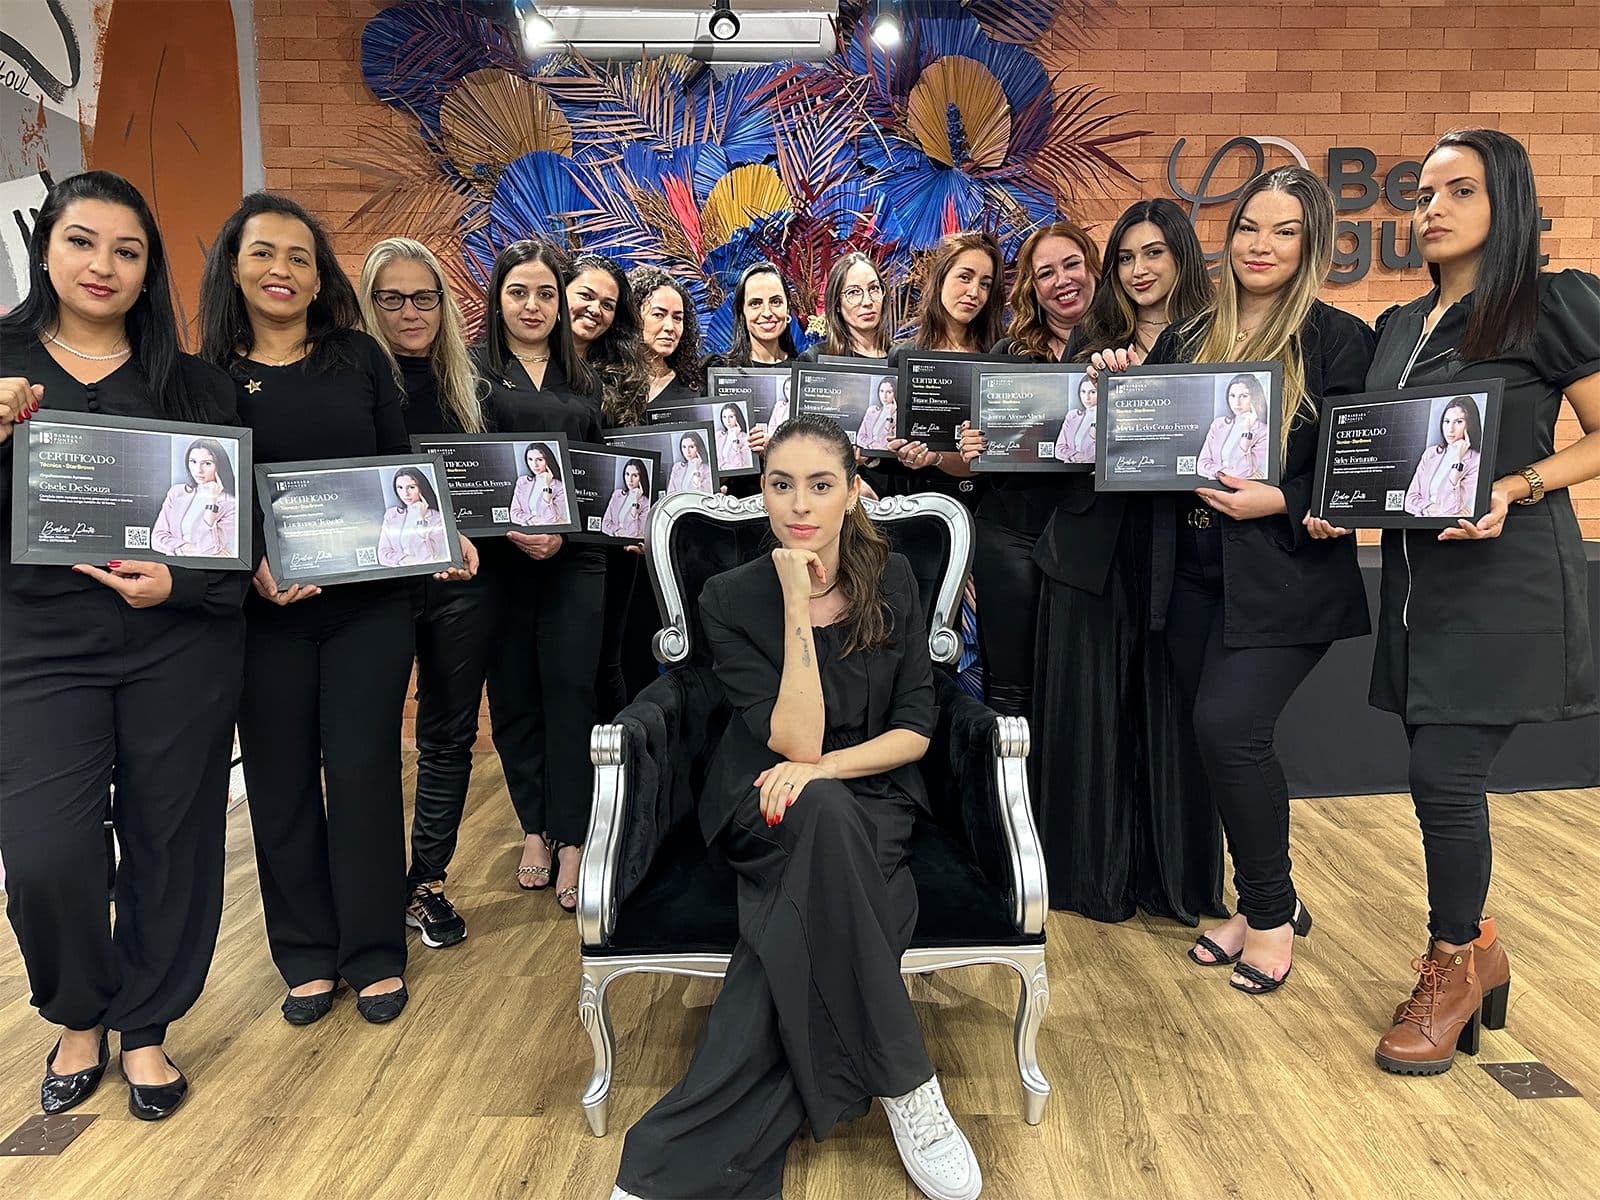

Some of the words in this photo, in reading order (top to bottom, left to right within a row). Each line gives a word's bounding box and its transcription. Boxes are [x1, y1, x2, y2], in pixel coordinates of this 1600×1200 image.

[1115, 399, 1171, 408] CERTIFICADO
[1336, 427, 1387, 439] CERTIFICADO
[39, 451, 115, 465] CERTIFICADO
[39, 480, 67, 492] Gisele
[68, 482, 83, 491] De
[84, 484, 111, 493] Souza
